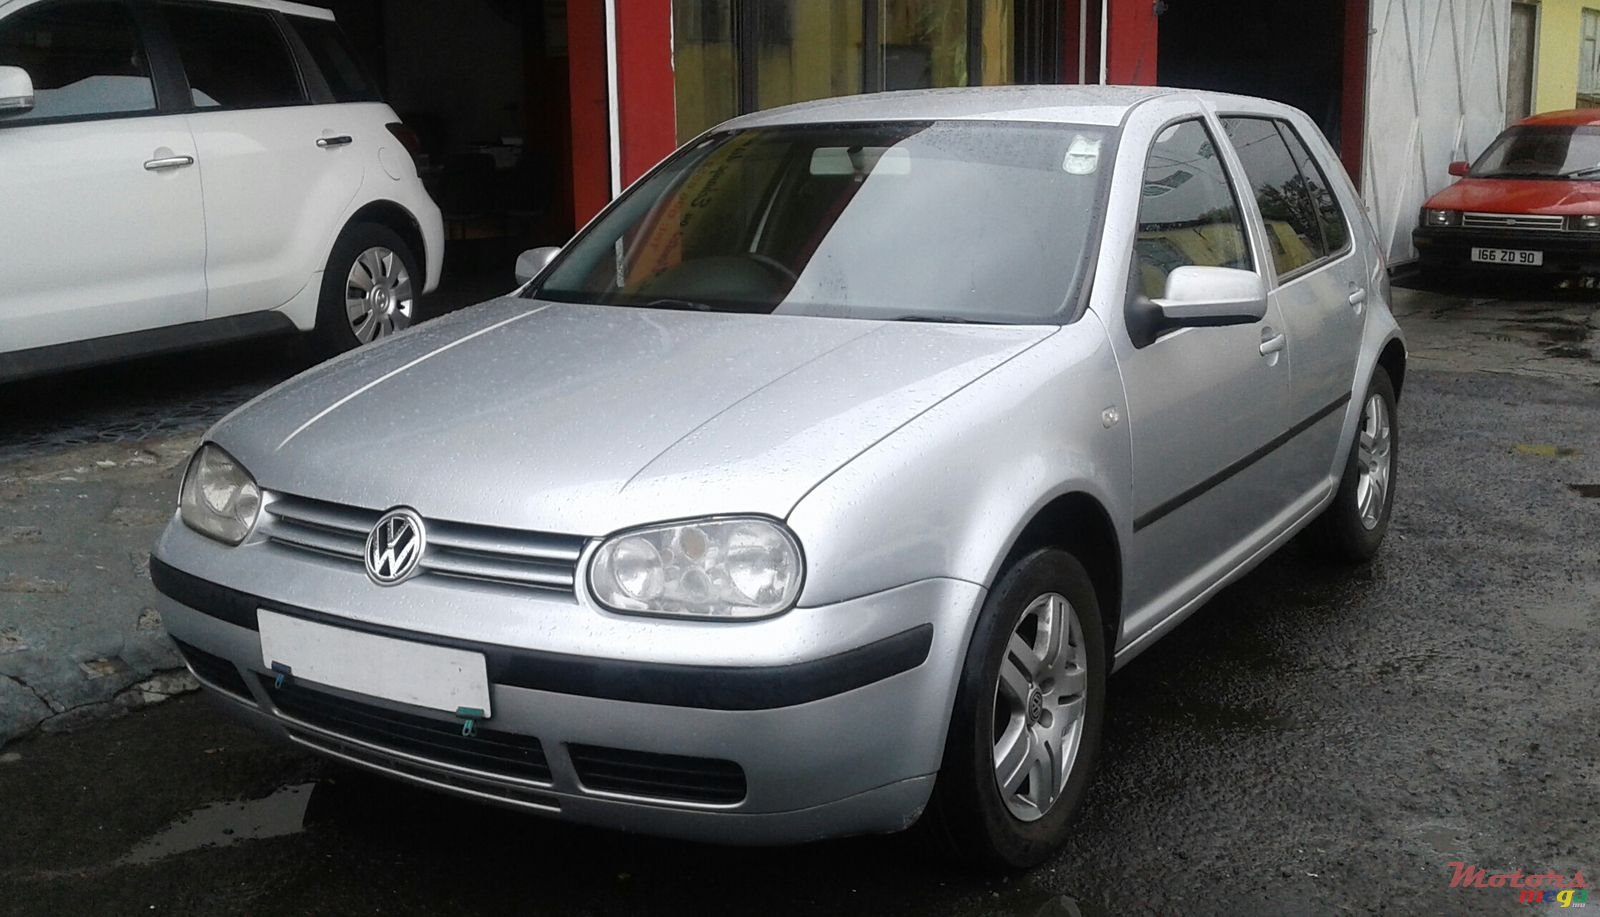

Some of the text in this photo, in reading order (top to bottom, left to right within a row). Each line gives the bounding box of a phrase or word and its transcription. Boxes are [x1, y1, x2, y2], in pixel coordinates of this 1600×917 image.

[1478, 249, 1535, 263] 166 ZD 90
[369, 514, 421, 580] VW
